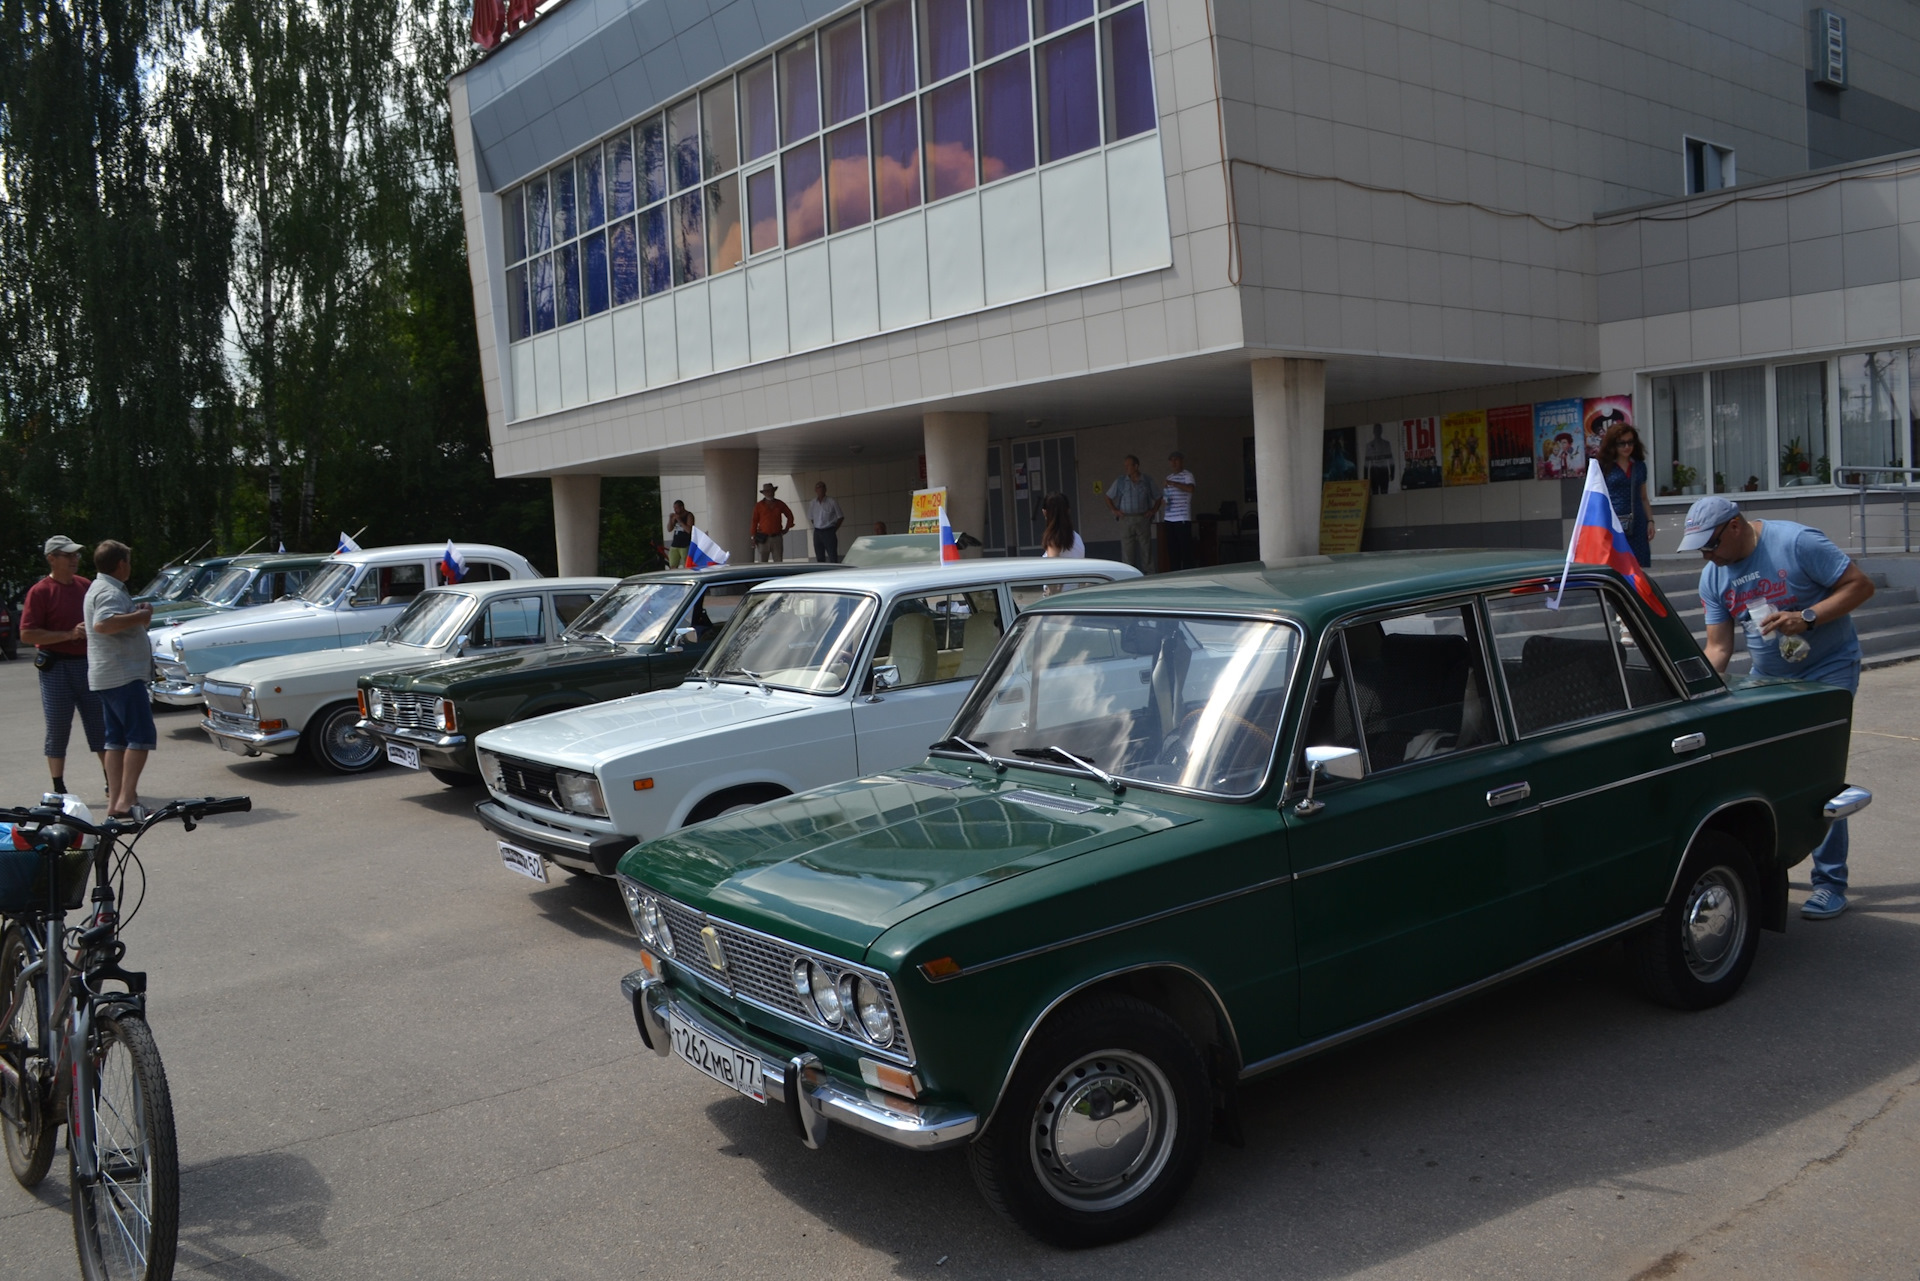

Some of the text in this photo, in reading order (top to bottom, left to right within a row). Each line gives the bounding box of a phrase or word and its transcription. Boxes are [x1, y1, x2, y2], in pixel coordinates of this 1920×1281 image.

[1539, 413, 1579, 427] ГРАМП!
[1403, 417, 1436, 450] ТЫ
[920, 495, 927, 508] 17
[932, 492, 942, 507] 29
[1732, 571, 1761, 587] VINTAGE
[407, 750, 417, 767] 52
[527, 855, 543, 879] 52
[736, 1054, 755, 1085] 77
[738, 1080, 754, 1095] RUS
